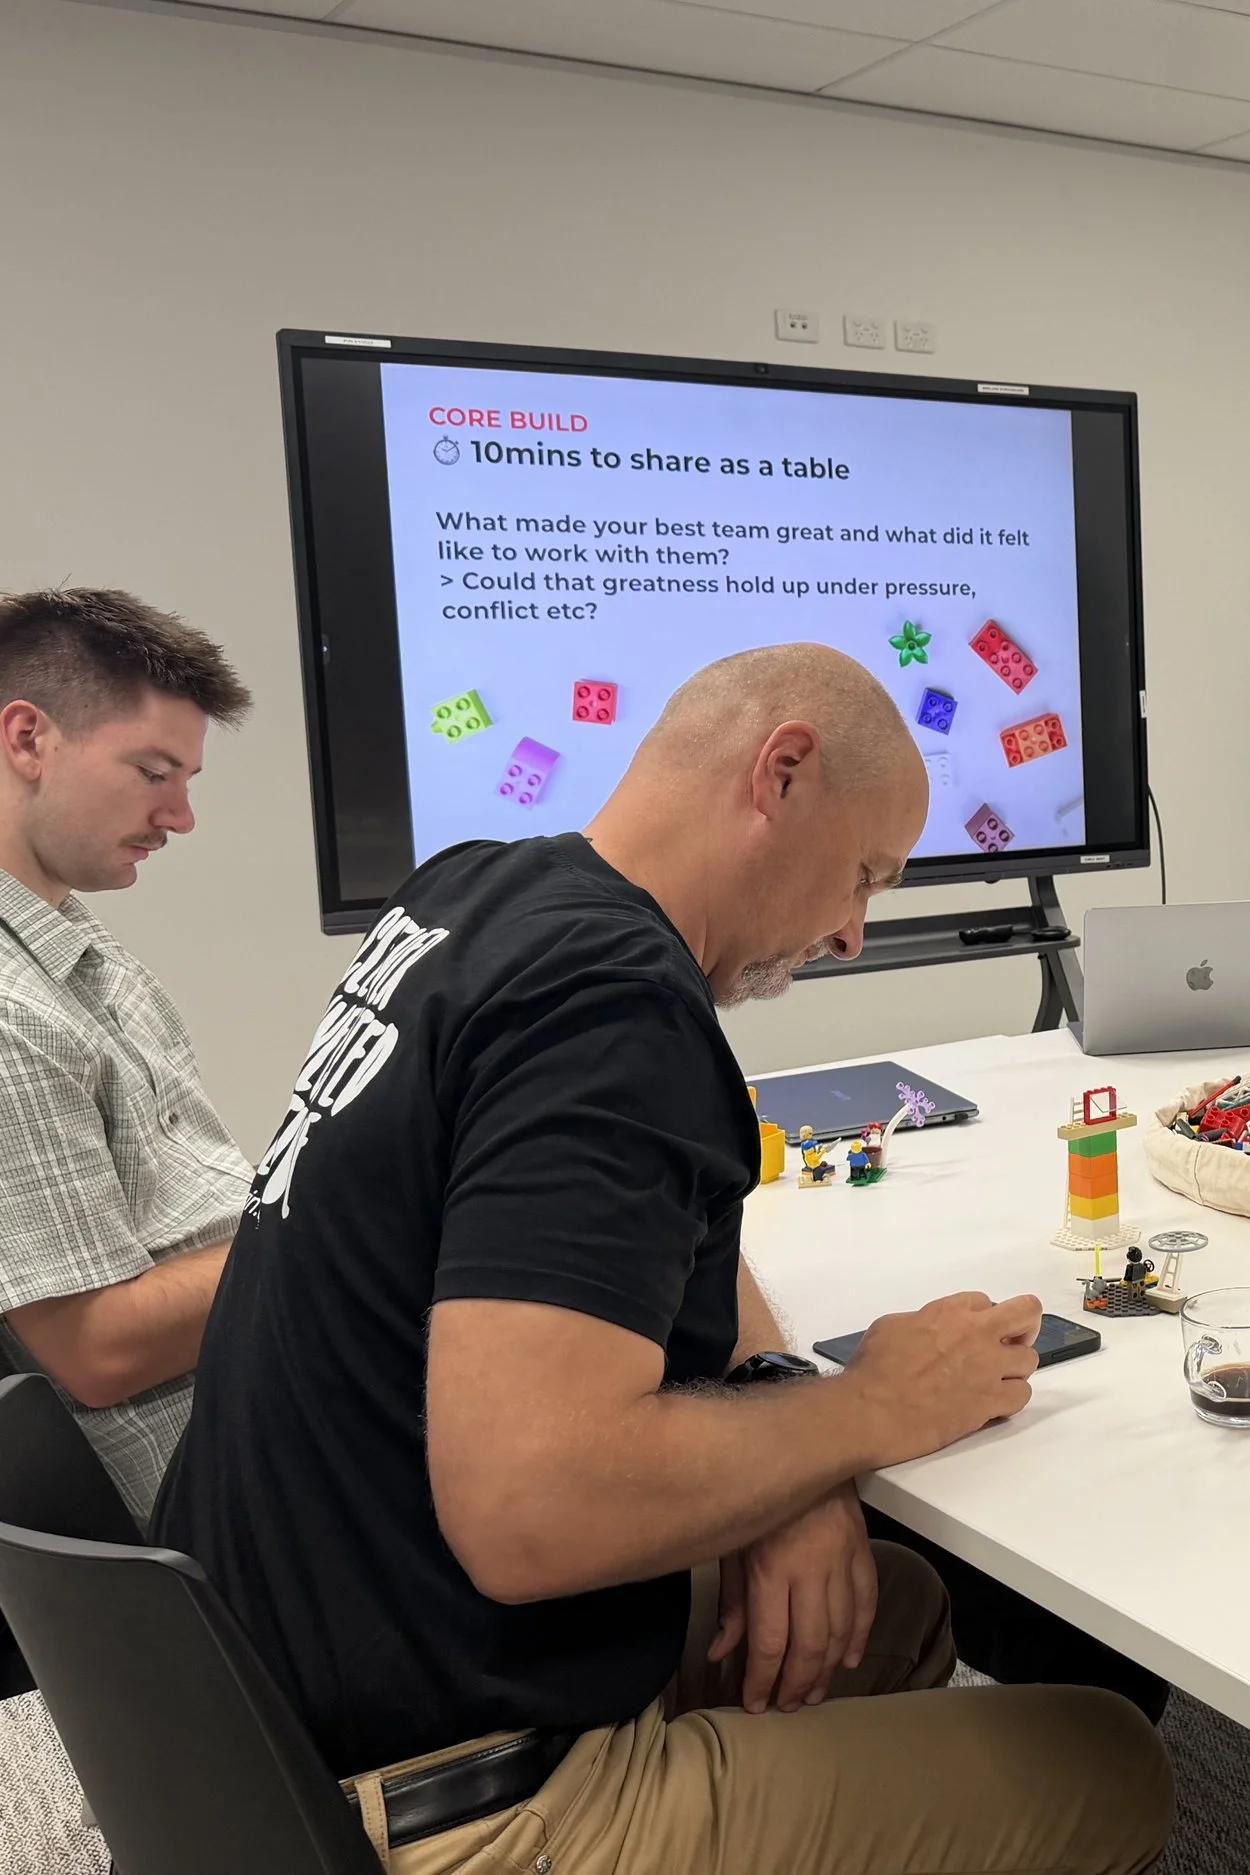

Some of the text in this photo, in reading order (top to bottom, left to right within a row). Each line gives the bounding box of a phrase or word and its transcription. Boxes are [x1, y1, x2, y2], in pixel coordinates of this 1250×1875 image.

[429, 406, 588, 433] CORE BUILD
[470, 440, 850, 481] 10mins to share as a table
[435, 511, 1030, 547] What made your best team great and what did it felt
[438, 540, 730, 566] like to work with them?
[462, 571, 536, 591] Could
[543, 572, 596, 592] that
[602, 575, 719, 596] greatness
[725, 575, 775, 594] hold
[782, 580, 810, 599] up
[816, 577, 879, 596] under
[885, 582, 976, 600] pressure,
[442, 599, 598, 620] conflict etc?
